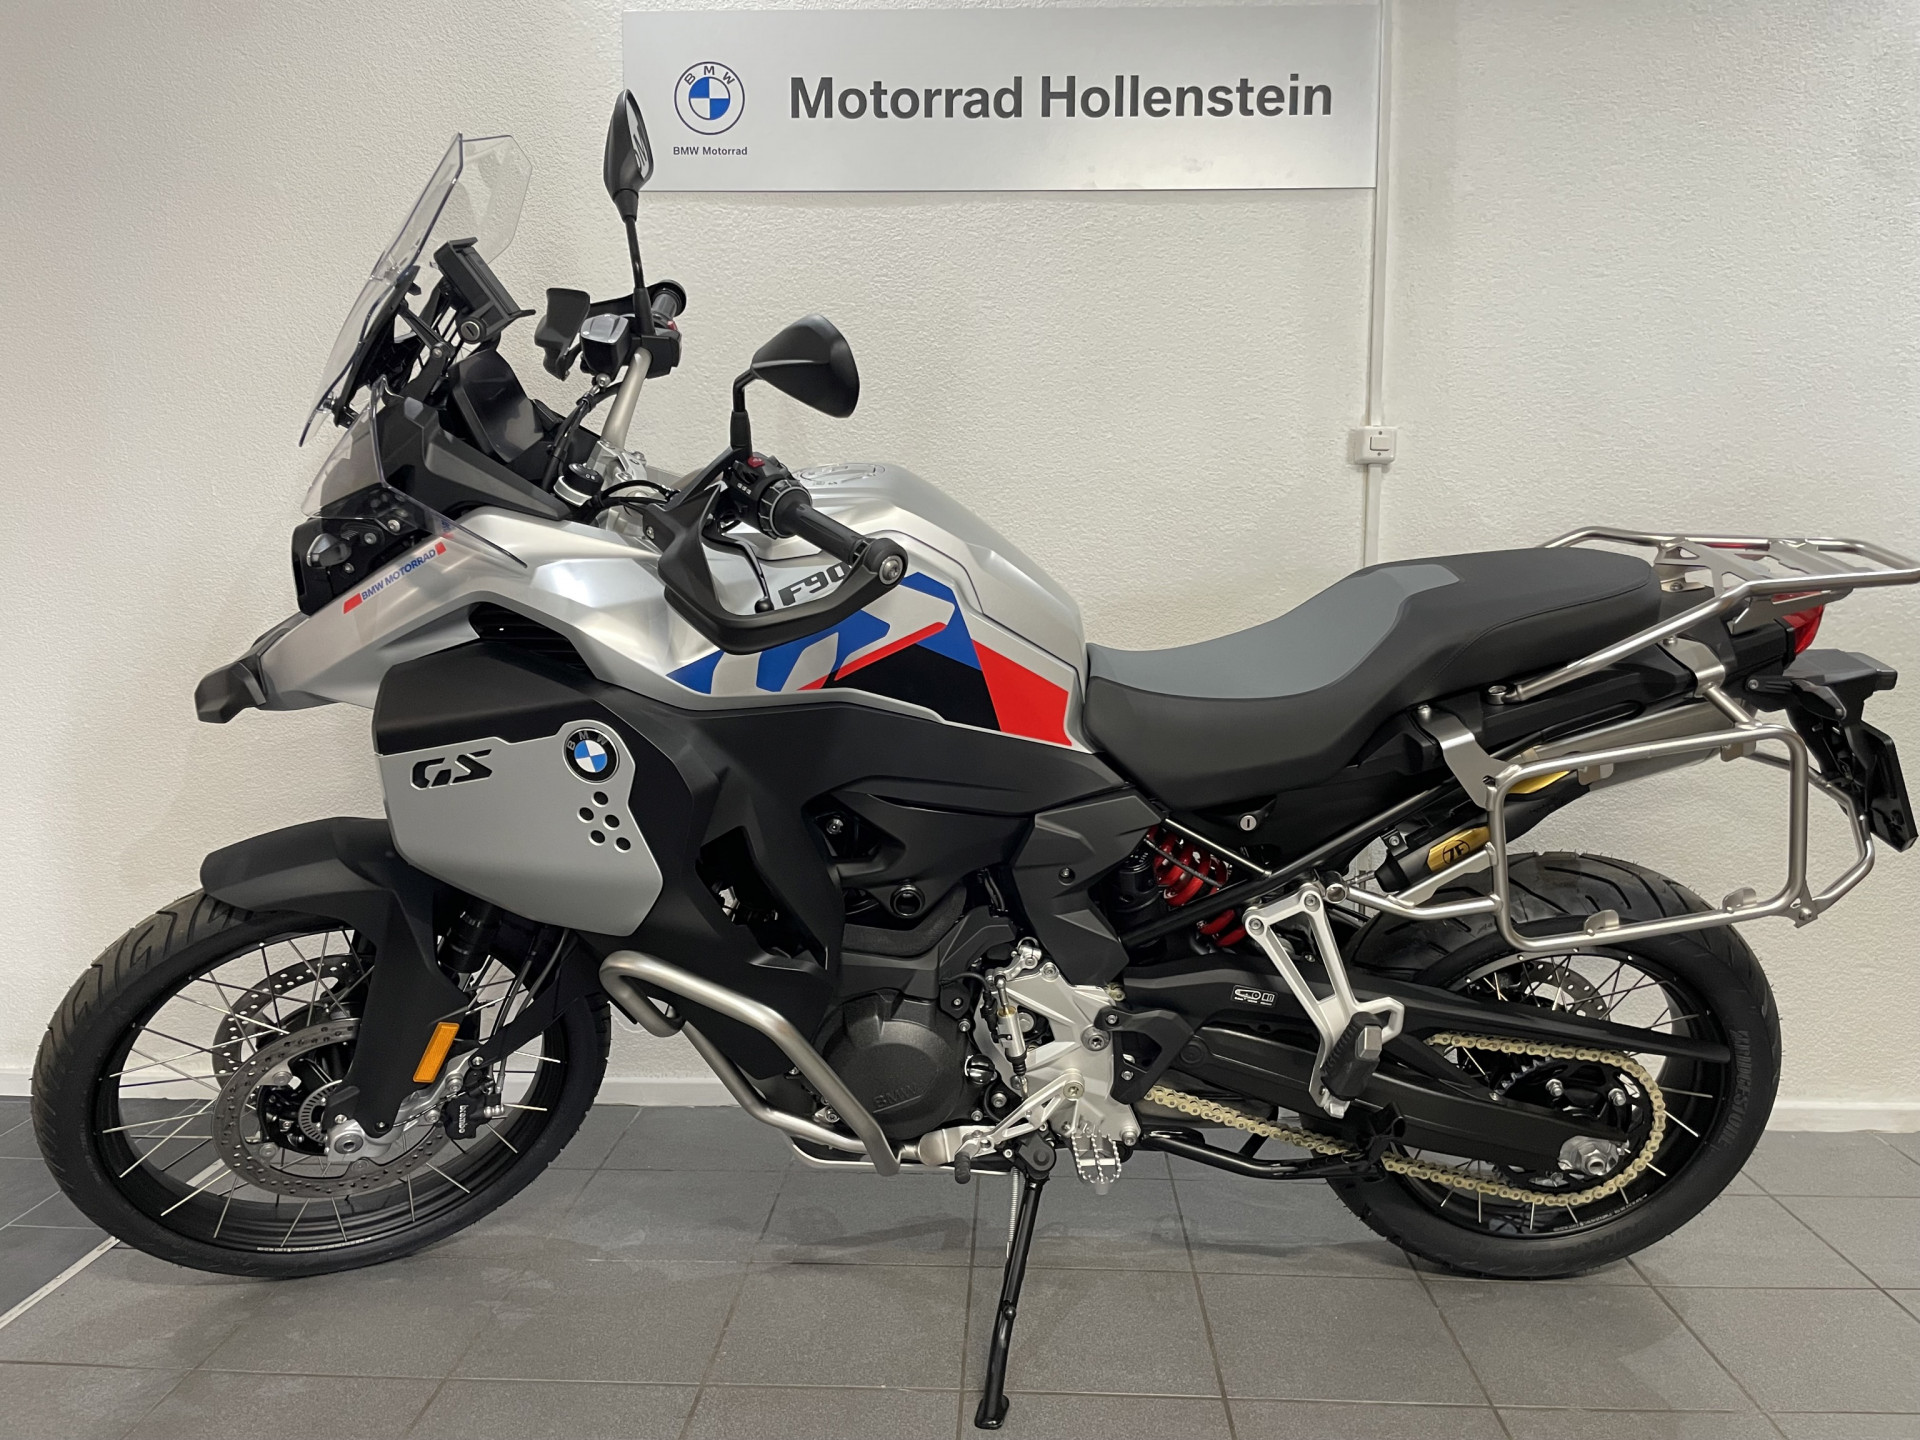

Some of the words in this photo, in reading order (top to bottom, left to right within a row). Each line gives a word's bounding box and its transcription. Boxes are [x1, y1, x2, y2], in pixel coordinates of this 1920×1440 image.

[684, 65, 735, 86] BMW
[791, 76, 1022, 119] Motorrad
[1041, 73, 1332, 118] Hollenstein
[673, 146, 699, 155] BMW
[702, 146, 748, 155] Motorrad
[361, 580, 384, 600] BMW
[385, 549, 436, 586] MOTORRAD
[411, 749, 493, 790] GS
[873, 1082, 918, 1109] BMW
[458, 1104, 469, 1134] brembo
